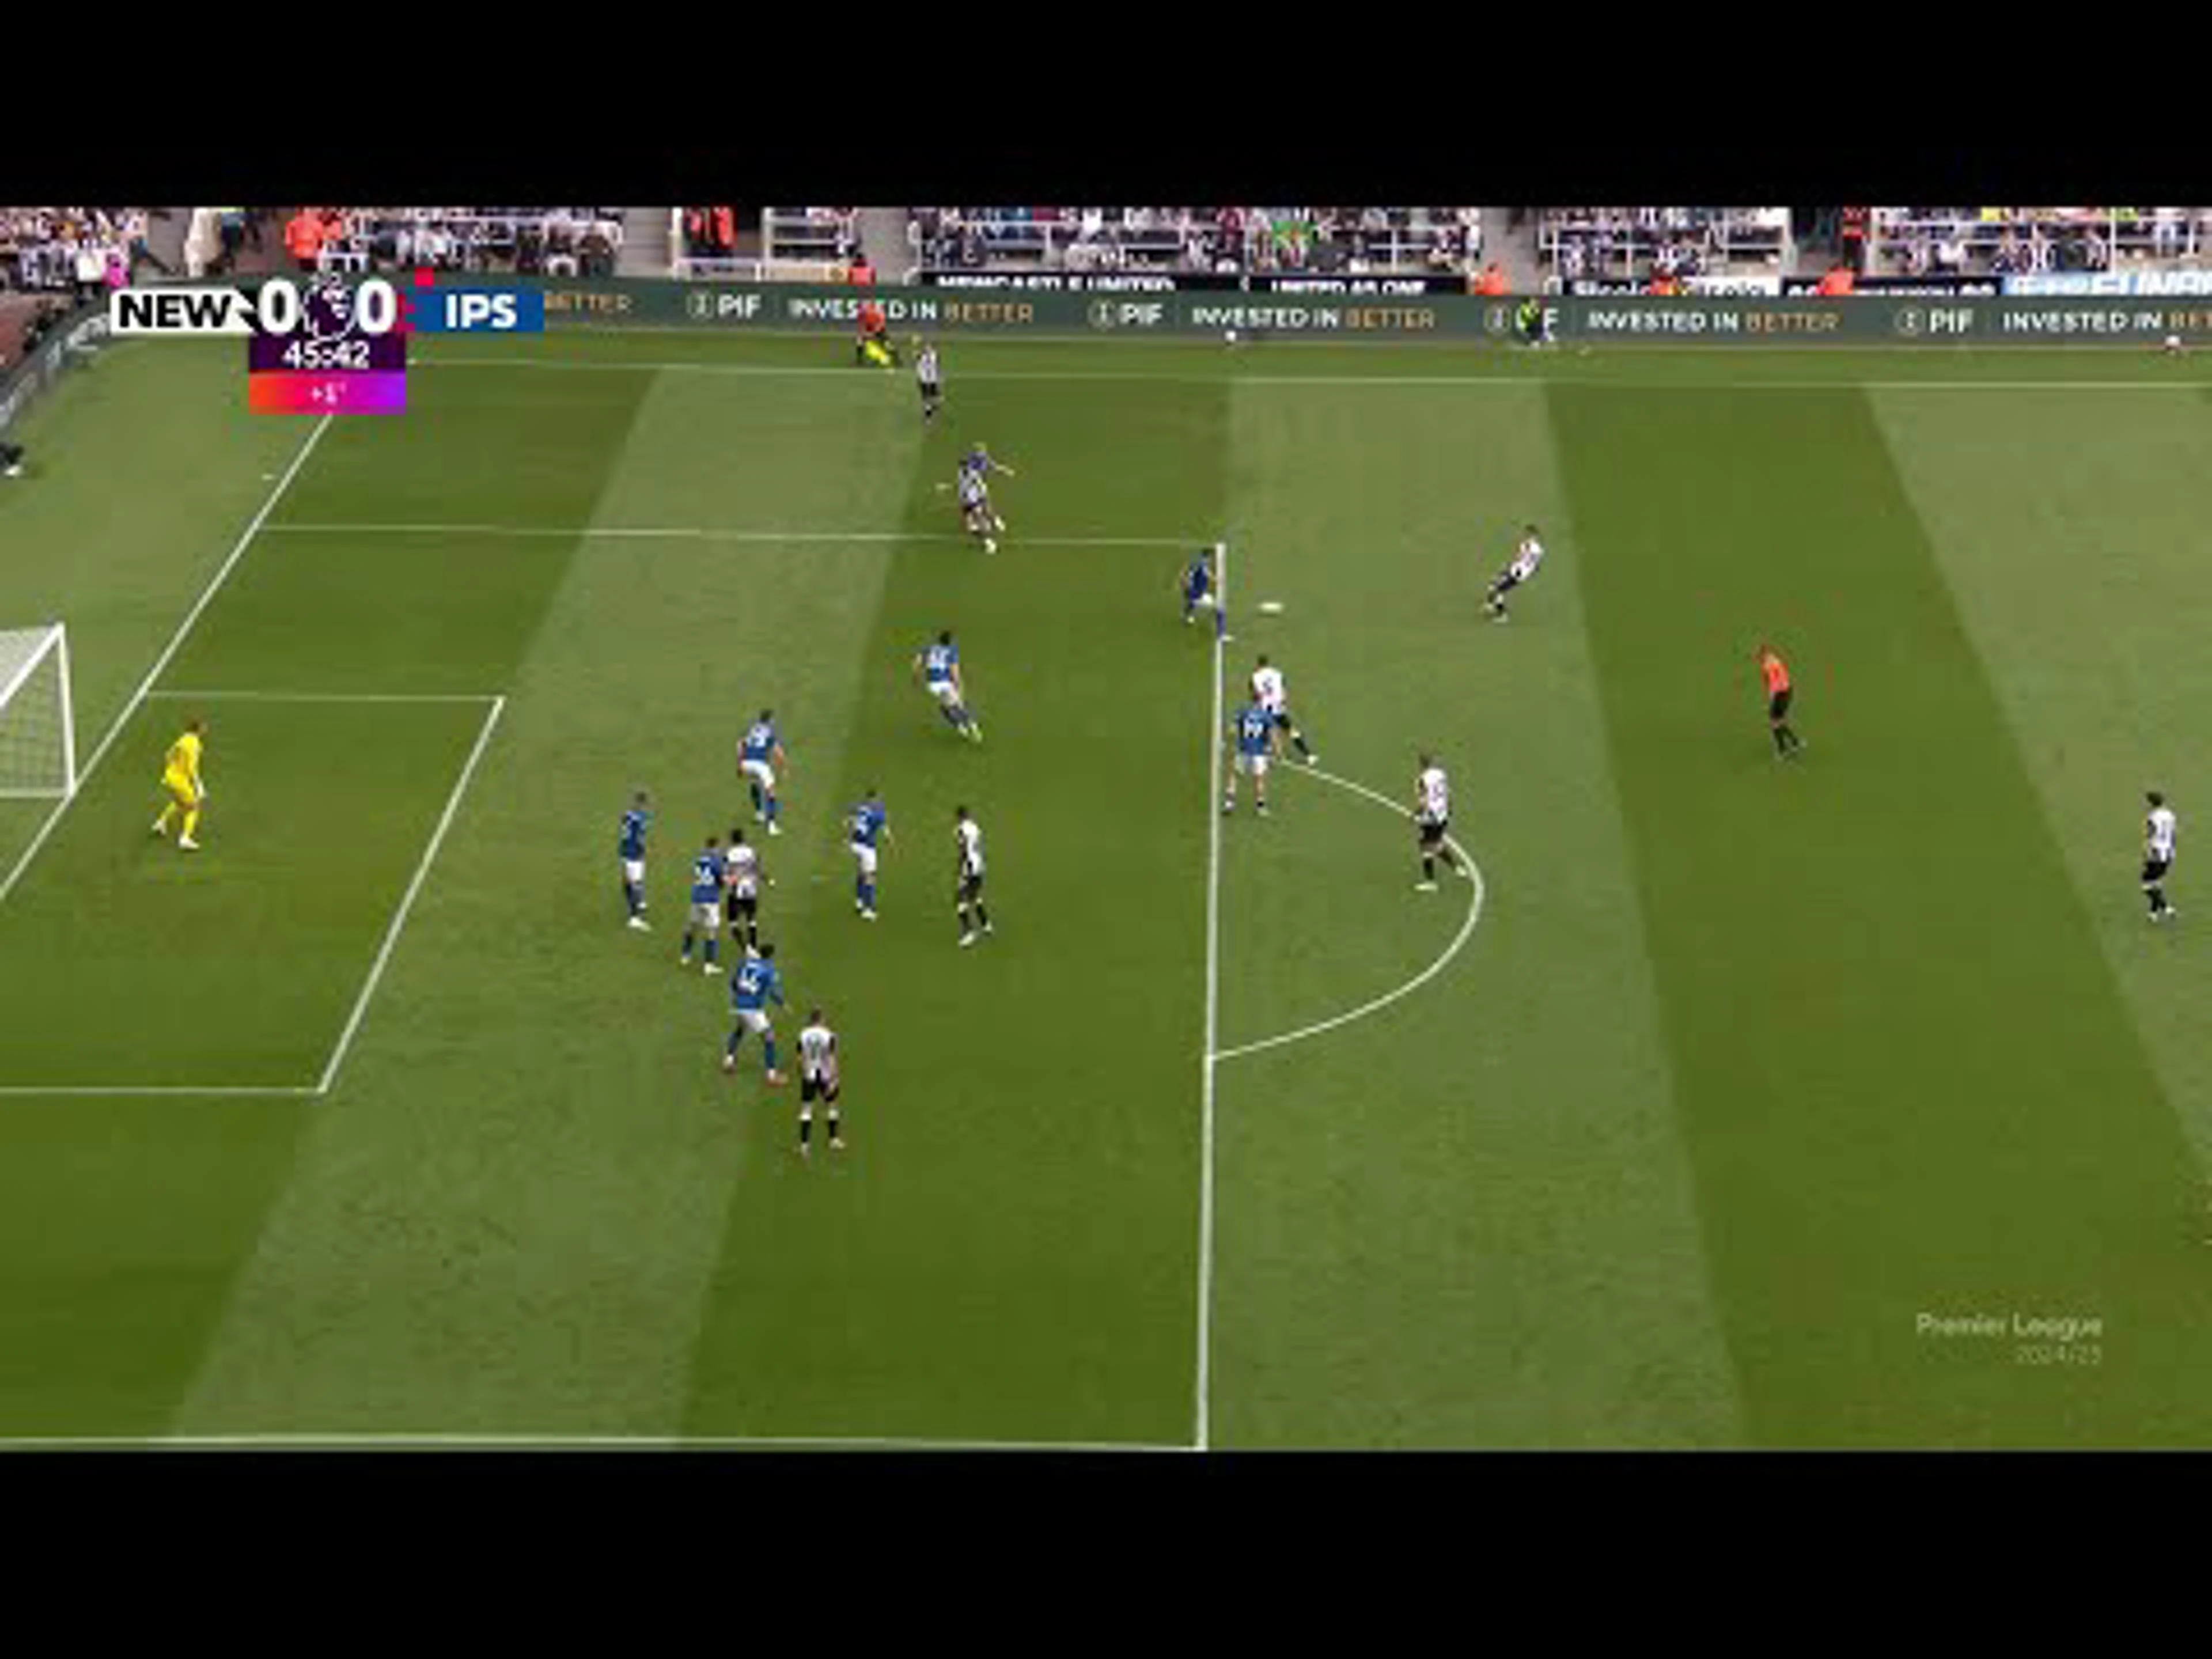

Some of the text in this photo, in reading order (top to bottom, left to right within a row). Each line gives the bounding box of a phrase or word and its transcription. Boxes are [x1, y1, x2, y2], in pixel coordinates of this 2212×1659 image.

[718, 293, 762, 319] PIF
[911, 300, 938, 320] IN
[945, 301, 1033, 323] BETTER
[1119, 302, 1162, 325] PIF
[1192, 307, 1435, 329] INVESTED IN BETTER
[1588, 311, 1840, 333] INVESTED IN BETTER
[1929, 309, 1974, 334] PIF
[2003, 311, 2130, 333] INVESTED
[2134, 312, 2162, 330] IN
